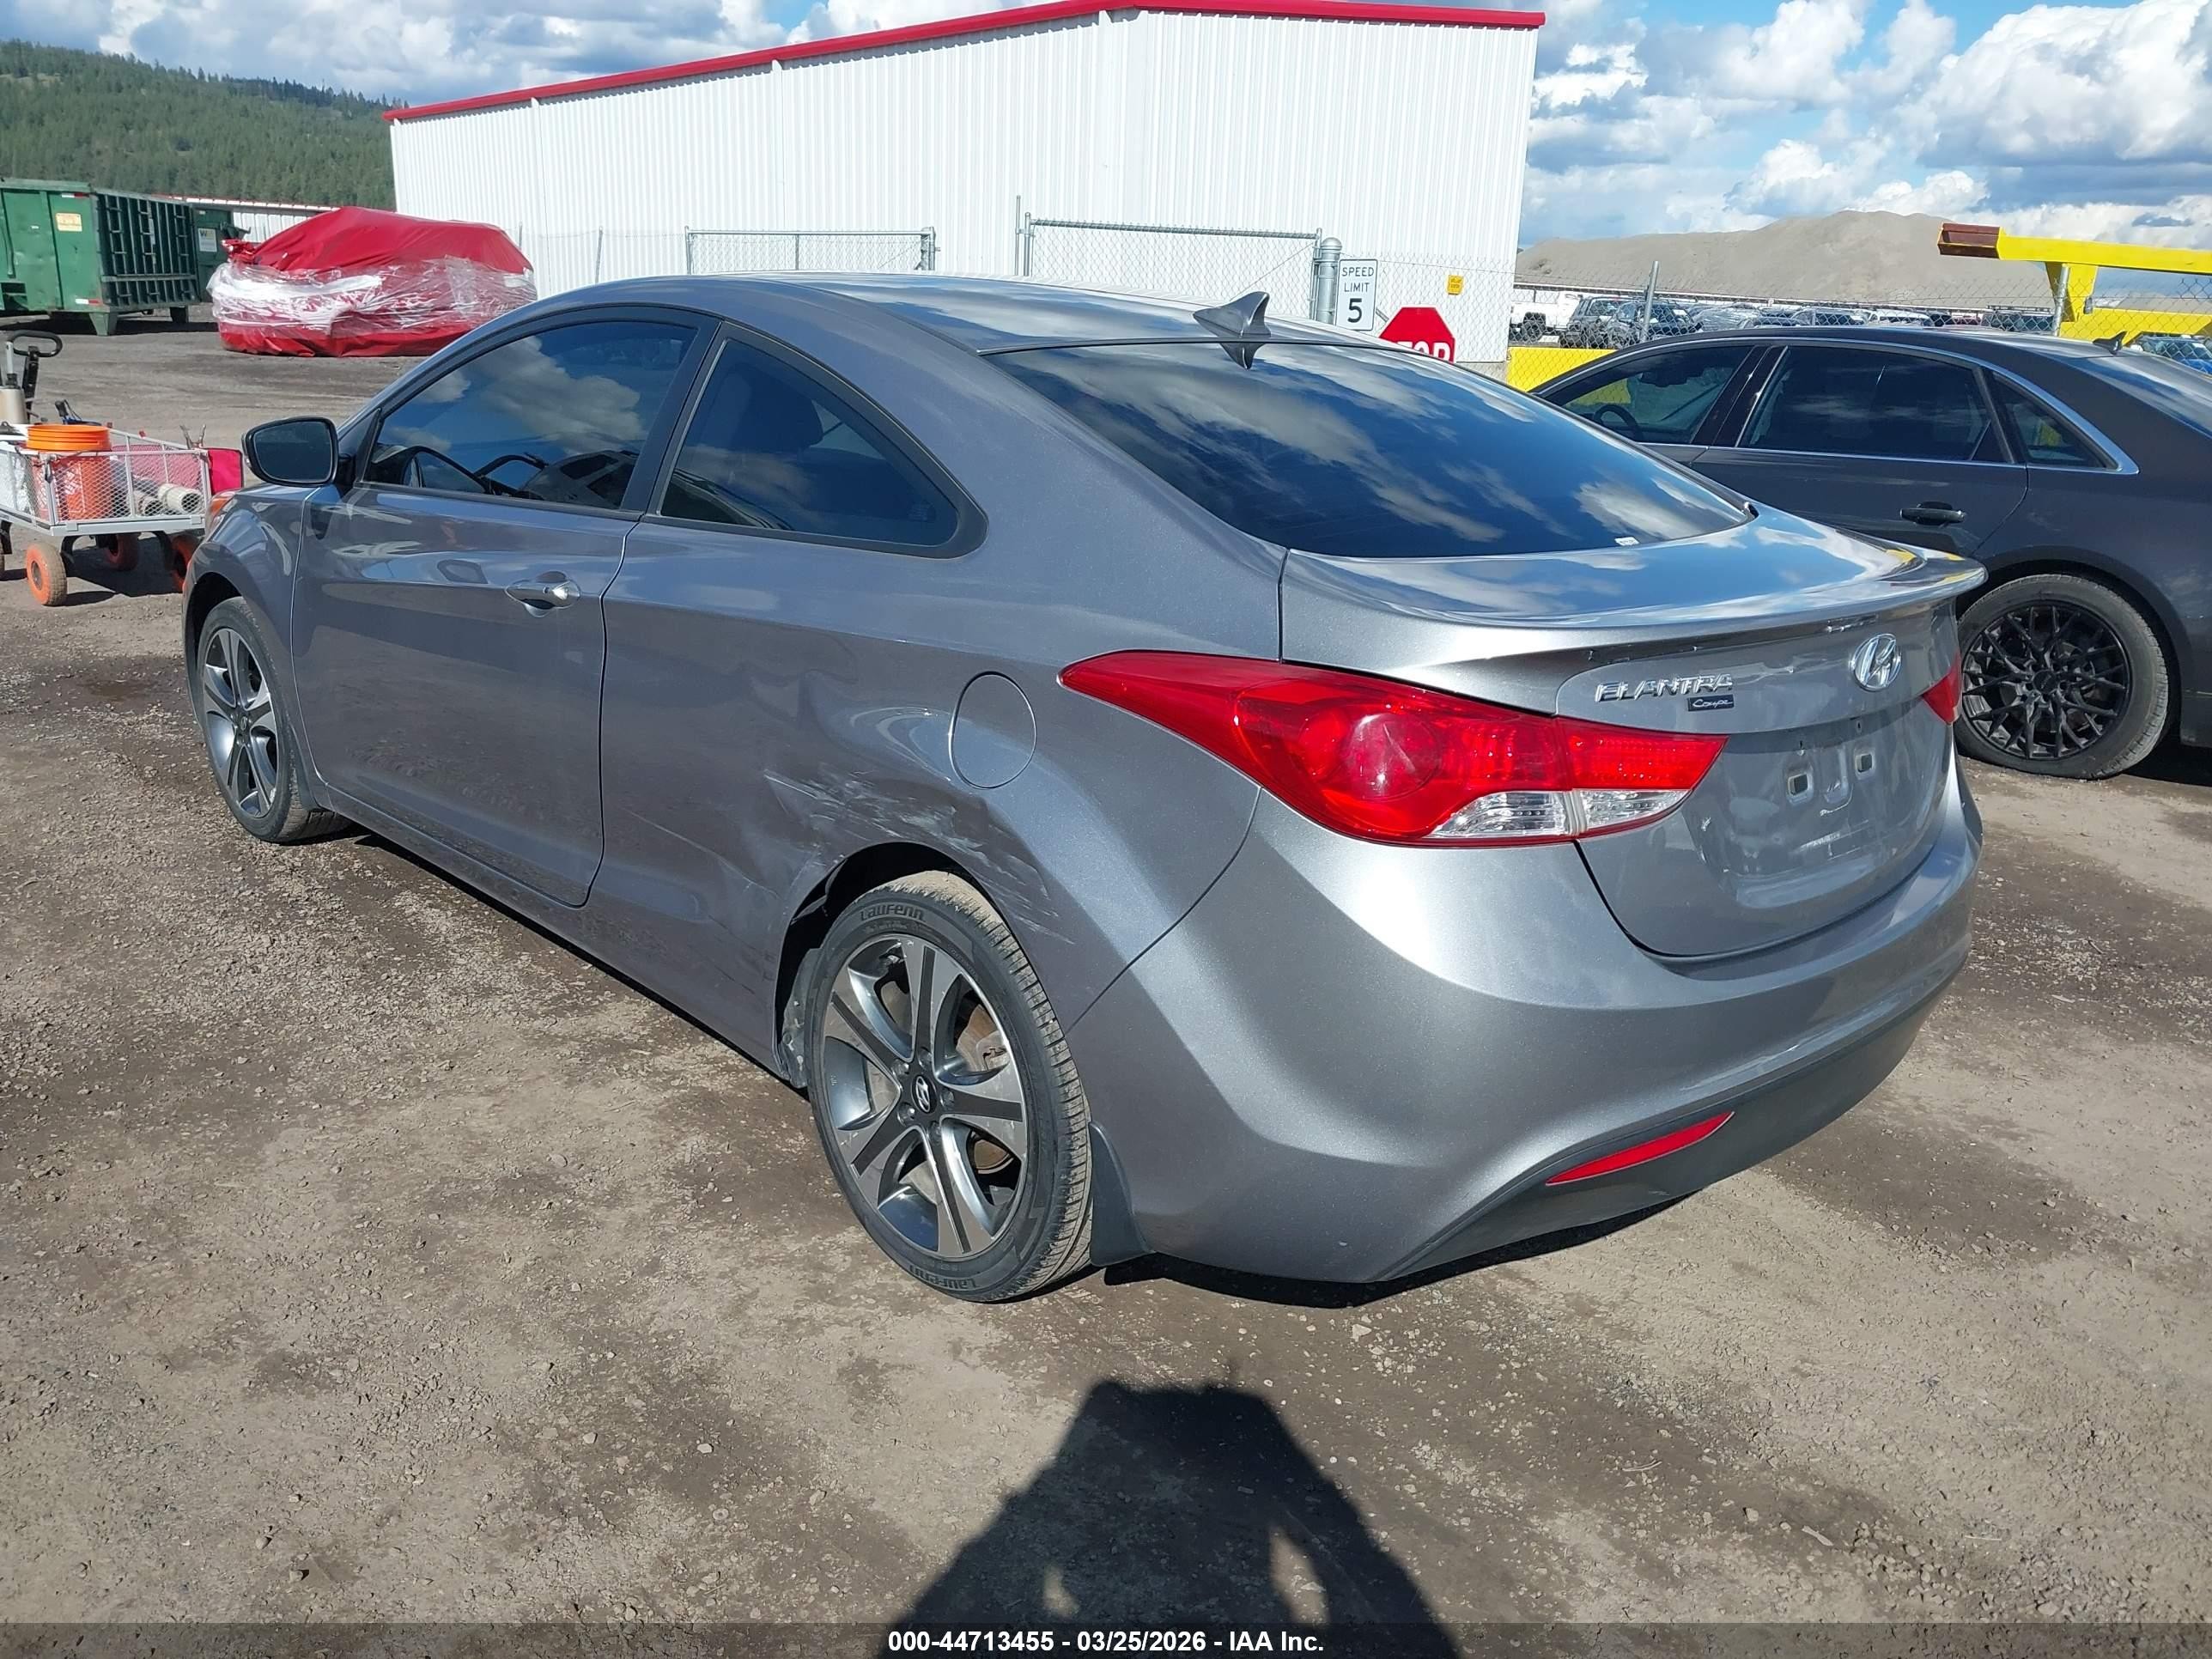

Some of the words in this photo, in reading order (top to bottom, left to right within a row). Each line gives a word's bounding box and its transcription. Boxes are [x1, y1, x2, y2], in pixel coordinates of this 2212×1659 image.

[1342, 266, 1375, 277] SPEED
[1344, 282, 1370, 293] LIMIT
[1347, 297, 1363, 324] 5
[1595, 673, 1733, 702] ELANTRA
[1692, 698, 1733, 708] Coupe
